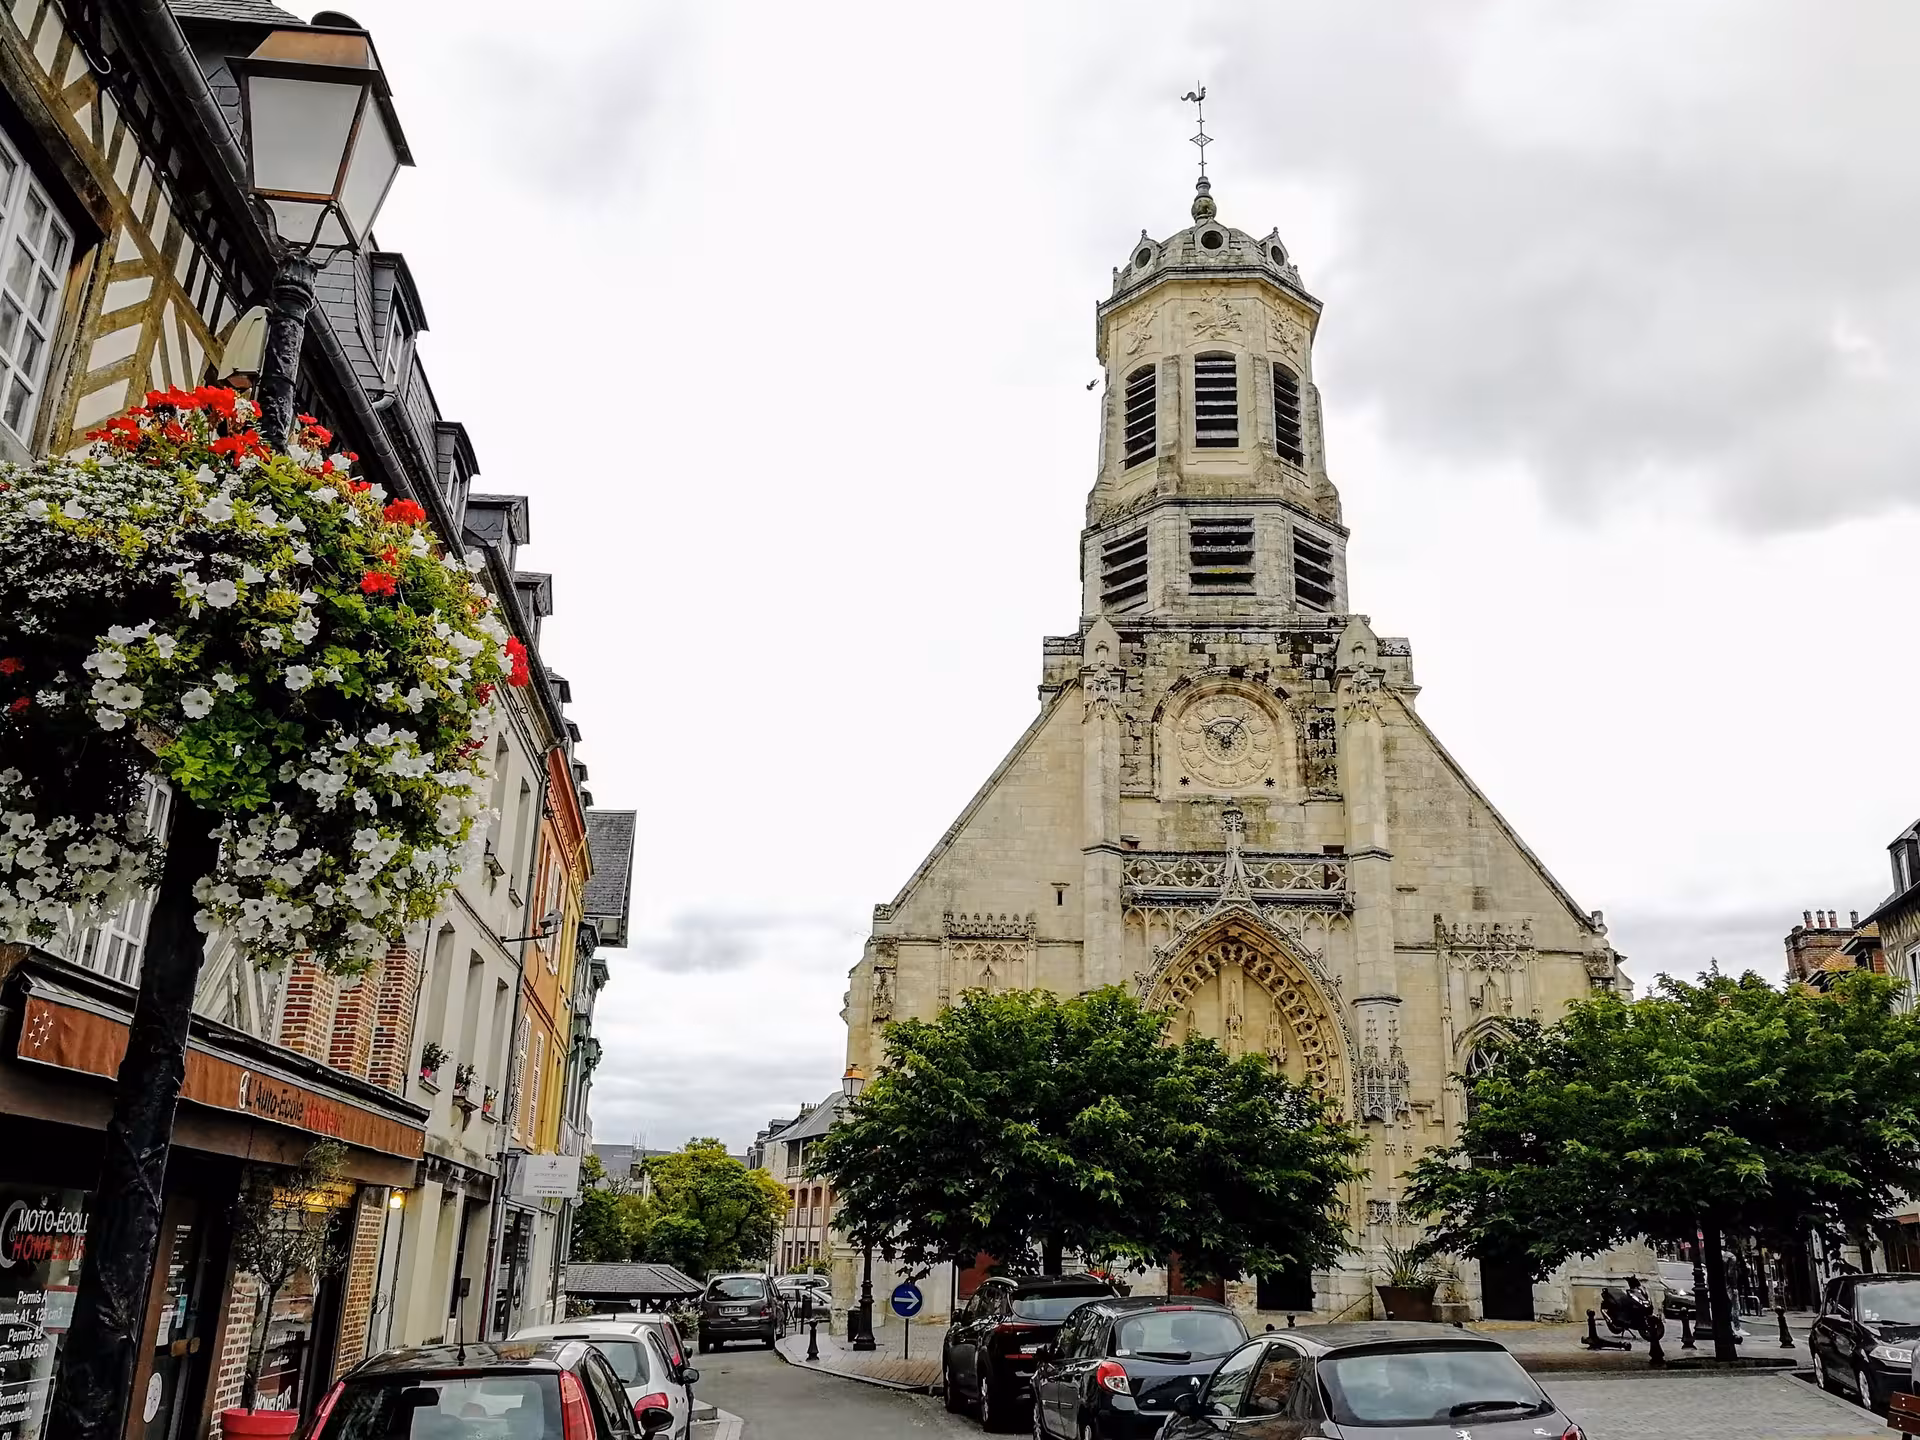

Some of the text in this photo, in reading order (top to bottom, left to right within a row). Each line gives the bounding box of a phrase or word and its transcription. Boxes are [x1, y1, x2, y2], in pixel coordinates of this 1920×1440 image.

[16, 1289, 48, 1305] Permis A
[0, 1309, 20, 1325] ermis
[20, 1308, 31, 1323] A1
[35, 1307, 48, 1322] 125
[7, 1326, 44, 1342] Permis A2
[0, 1347, 20, 1362] ermis
